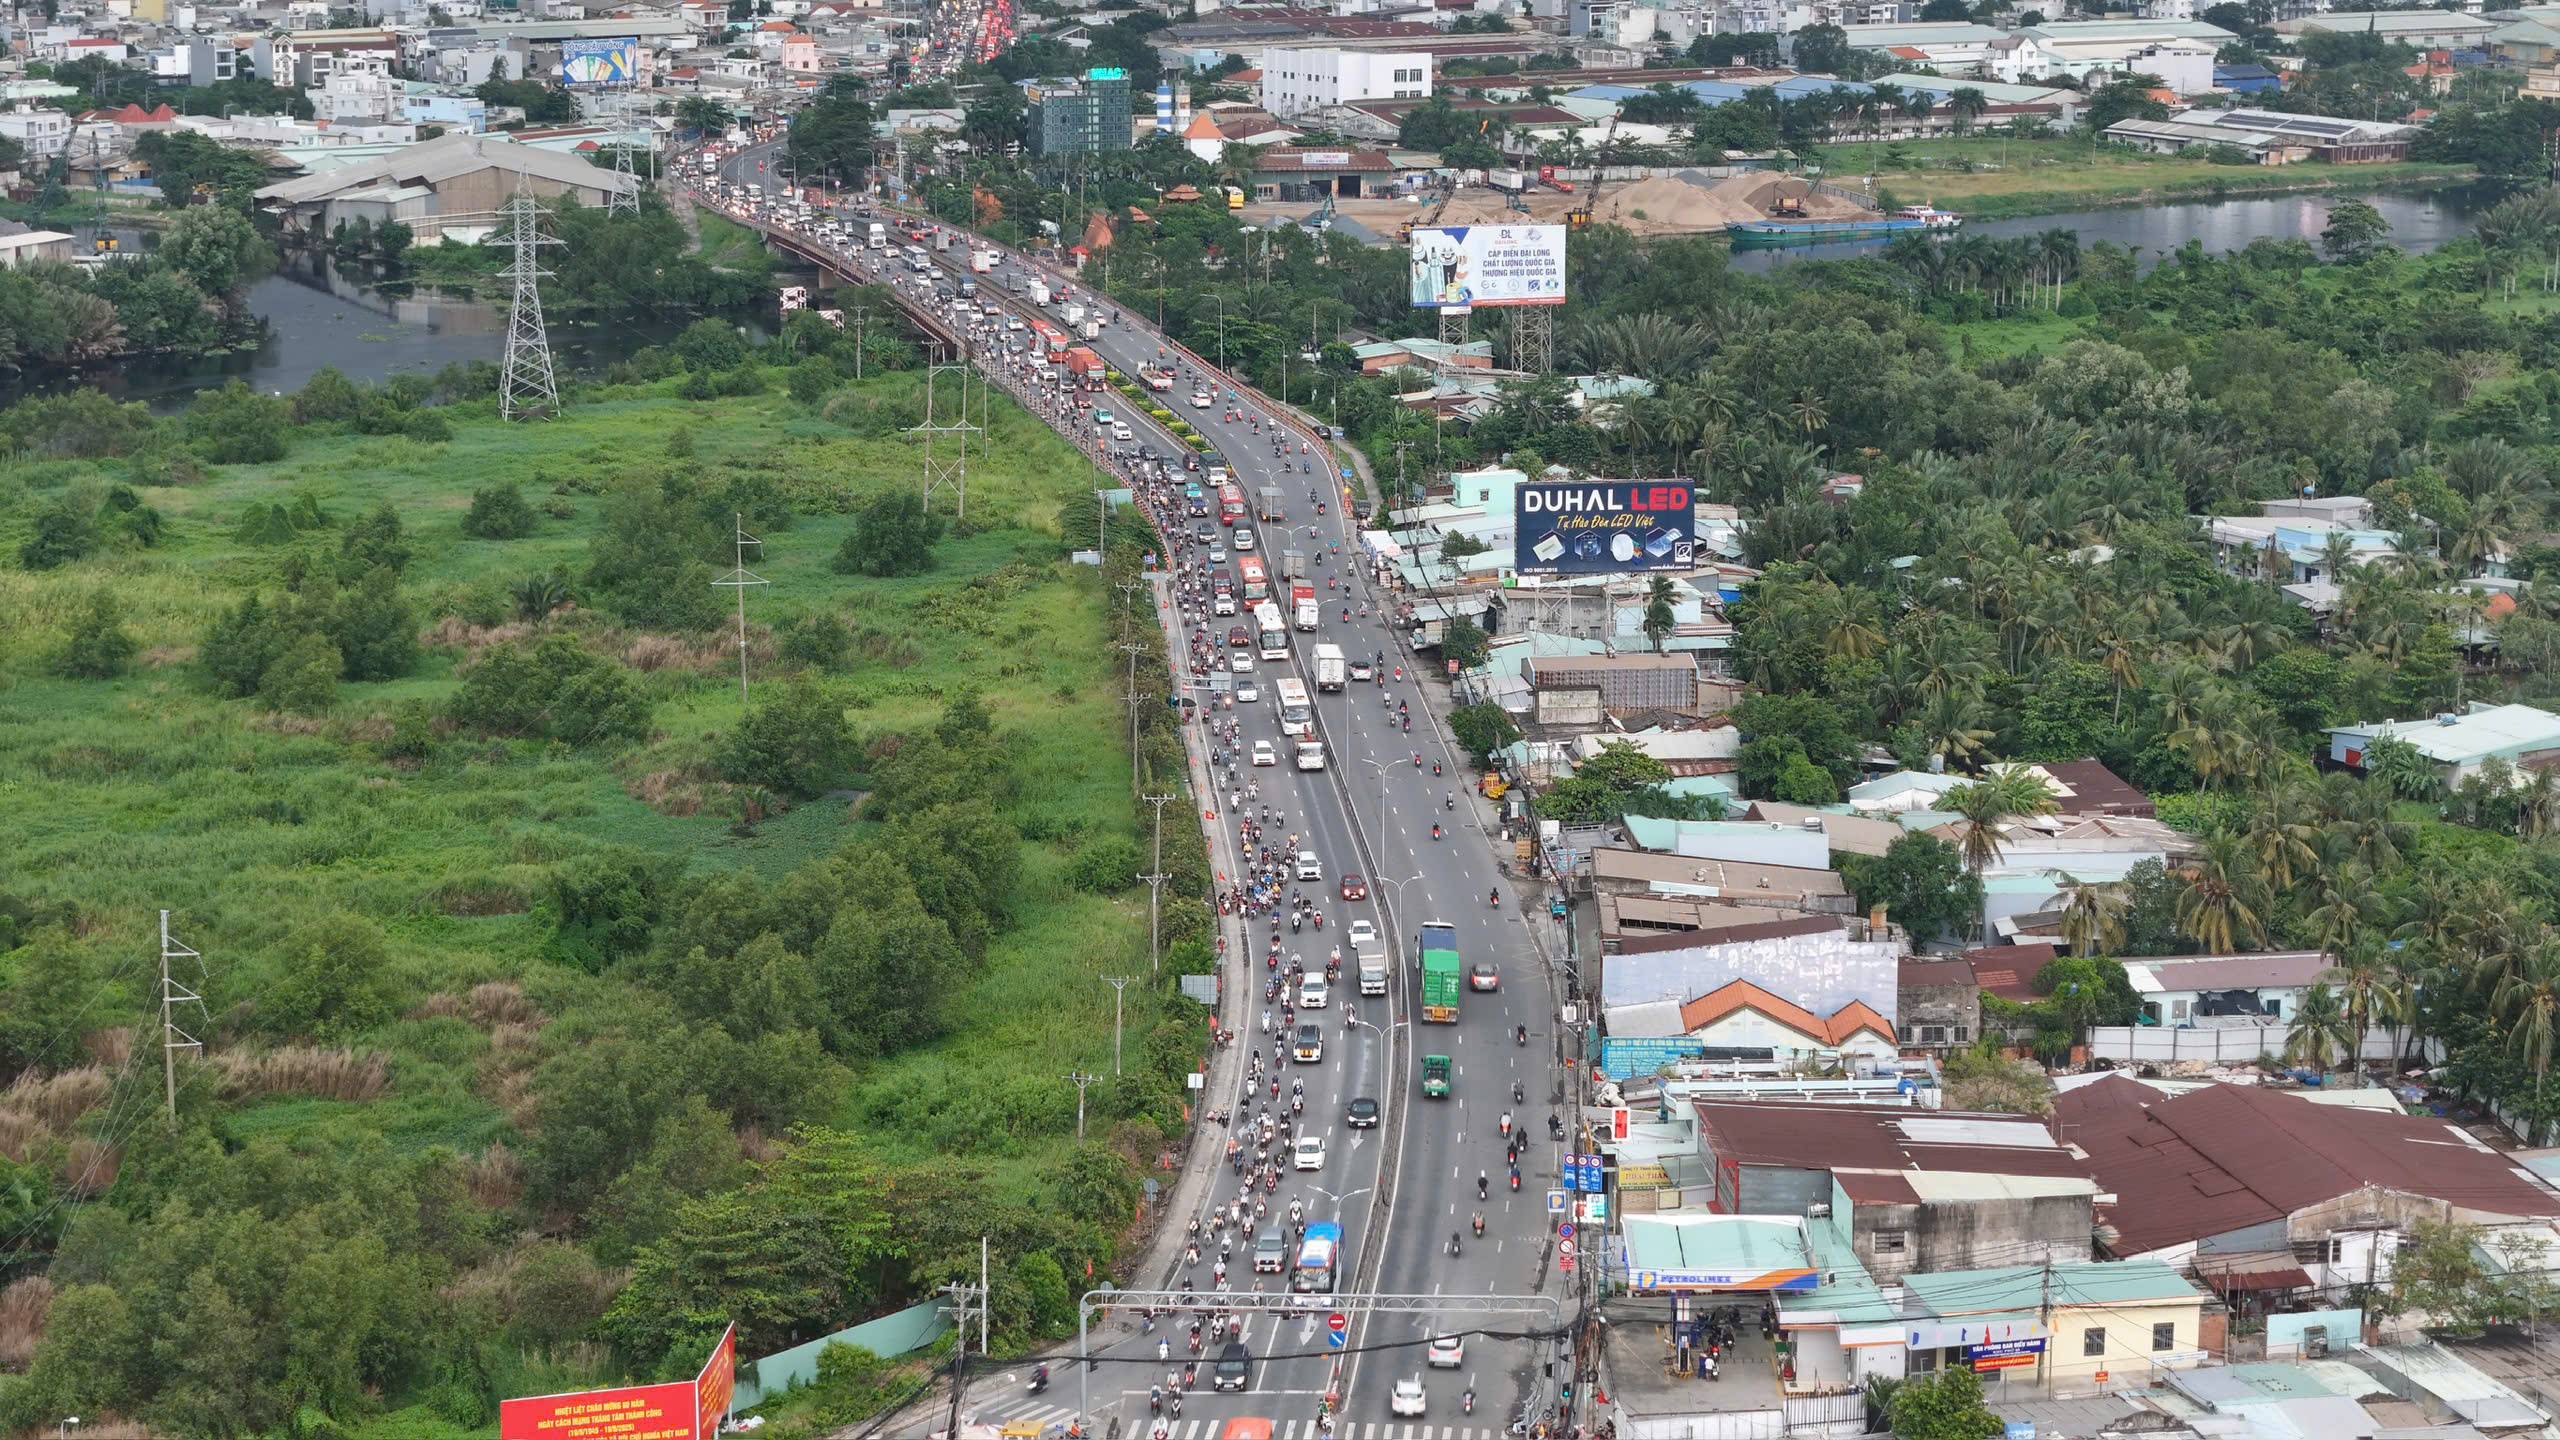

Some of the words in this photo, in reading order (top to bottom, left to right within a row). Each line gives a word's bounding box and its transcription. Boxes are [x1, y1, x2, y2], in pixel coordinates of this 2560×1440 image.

[1533, 248, 1551, 257] LONG
[1483, 257, 1500, 268] CHẤT
[1502, 258, 1523, 269] LƯỢNG
[1525, 256, 1543, 267] QUỐC
[1544, 258, 1556, 266] GIA
[1482, 268, 1508, 278] THƯƠNG
[1510, 267, 1525, 277] HIỆU
[1526, 266, 1544, 277] QUỐC
[1545, 267, 1557, 276] GIA
[1525, 489, 1623, 512] DUHAL
[1631, 487, 1688, 511] LED
[1557, 515, 1570, 531] Tự
[1571, 514, 1589, 529] Hào
[1591, 513, 1610, 529] Đèn
[1611, 513, 1633, 528] LED
[1635, 513, 1656, 529] Việt
[554, 1406, 573, 1417] NHIỆT
[573, 1405, 585, 1415] LIỆT
[555, 1417, 571, 1428] CÁCH
[591, 1413, 611, 1424] THÁNG
[645, 1407, 662, 1418] CÔNG
[661, 1429, 675, 1439] VIỆT
[675, 1428, 689, 1437] NAM
